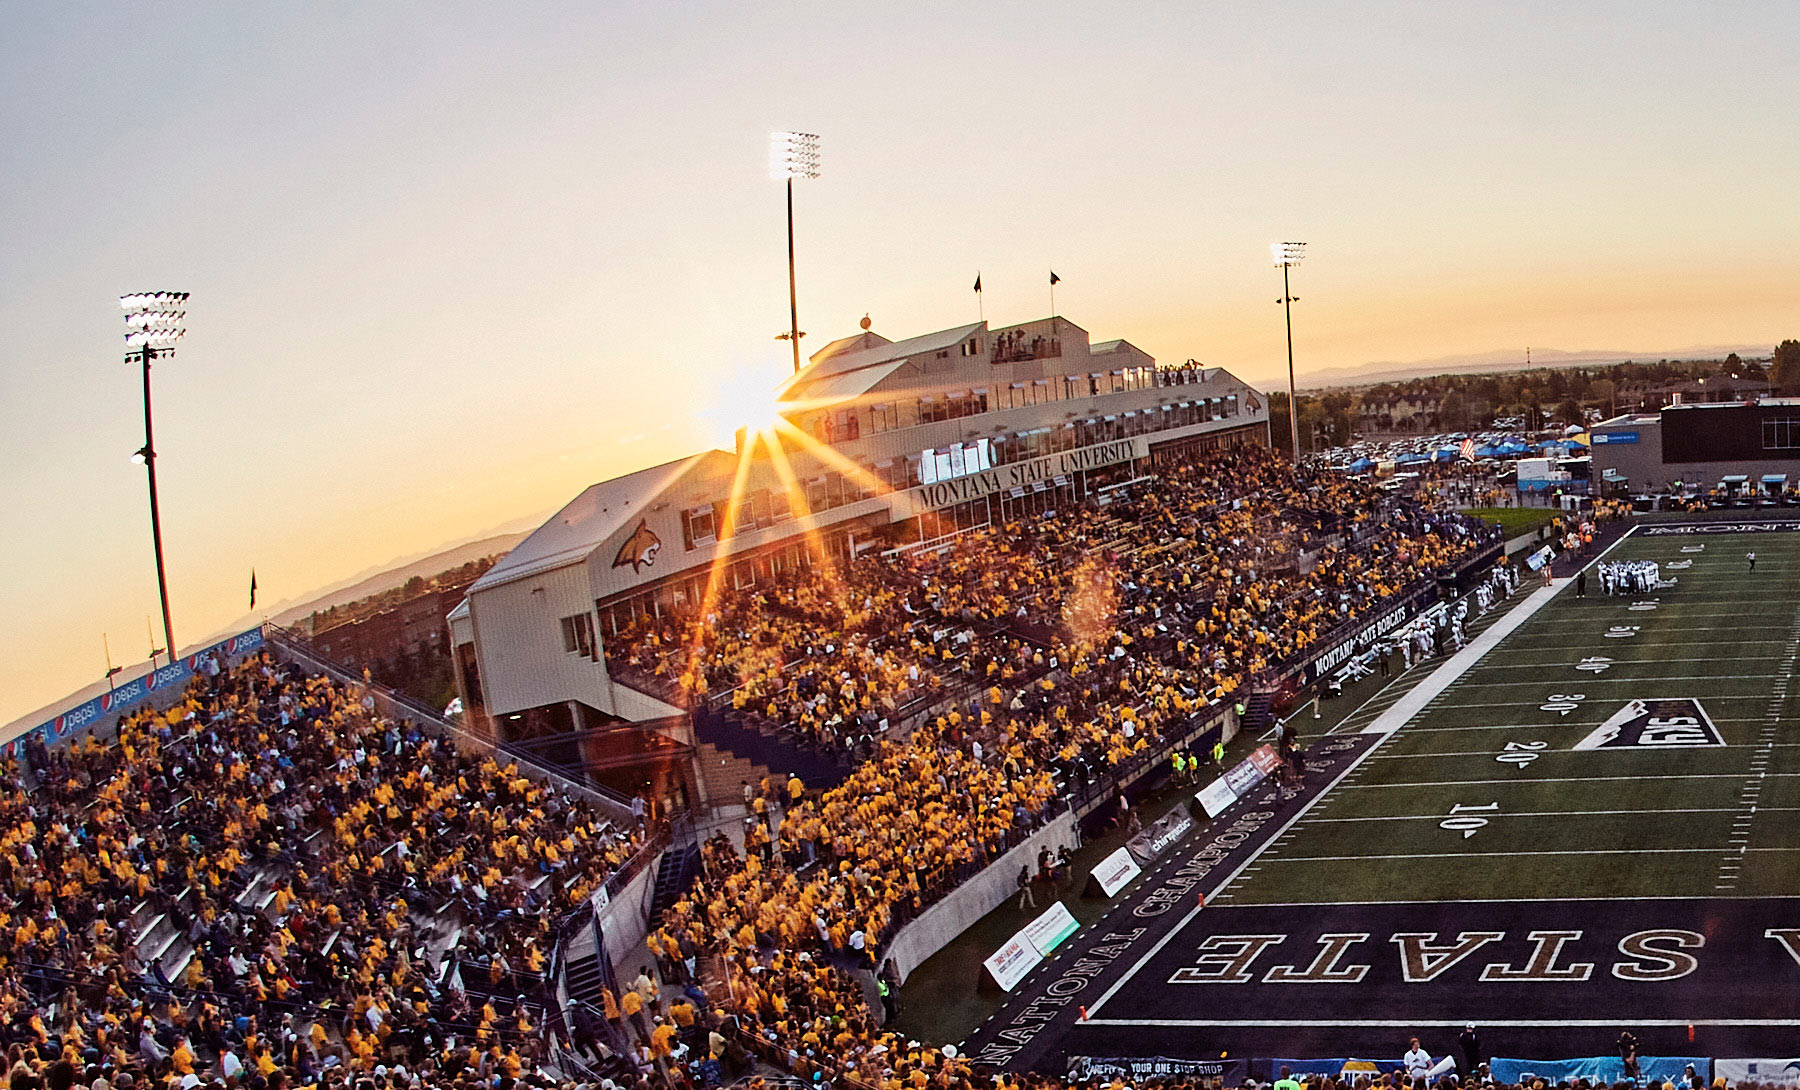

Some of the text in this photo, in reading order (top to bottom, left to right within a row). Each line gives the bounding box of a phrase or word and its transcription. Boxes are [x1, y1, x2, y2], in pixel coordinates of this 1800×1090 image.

[919, 439, 1136, 509] MONTANA STATE UNIVERSITY
[1377, 606, 1406, 637] BOBCATS
[238, 627, 262, 651] pepsi
[156, 662, 183, 688] pepsi
[113, 682, 141, 705] pepsi
[1539, 694, 1586, 711] 30
[67, 700, 96, 730] pepsi
[1496, 741, 1548, 762] 20
[1440, 802, 1499, 830] 10
[974, 926, 1147, 1067] NATIONAL
[1132, 810, 1275, 918] CHAMPIONS
[1168, 928, 1706, 984] STATE
[1130, 1062, 1152, 1073] YOUR
[1154, 1062, 1170, 1073] ONE
[1174, 1064, 1196, 1074] STOP
[1198, 1064, 1223, 1075] SHOP
